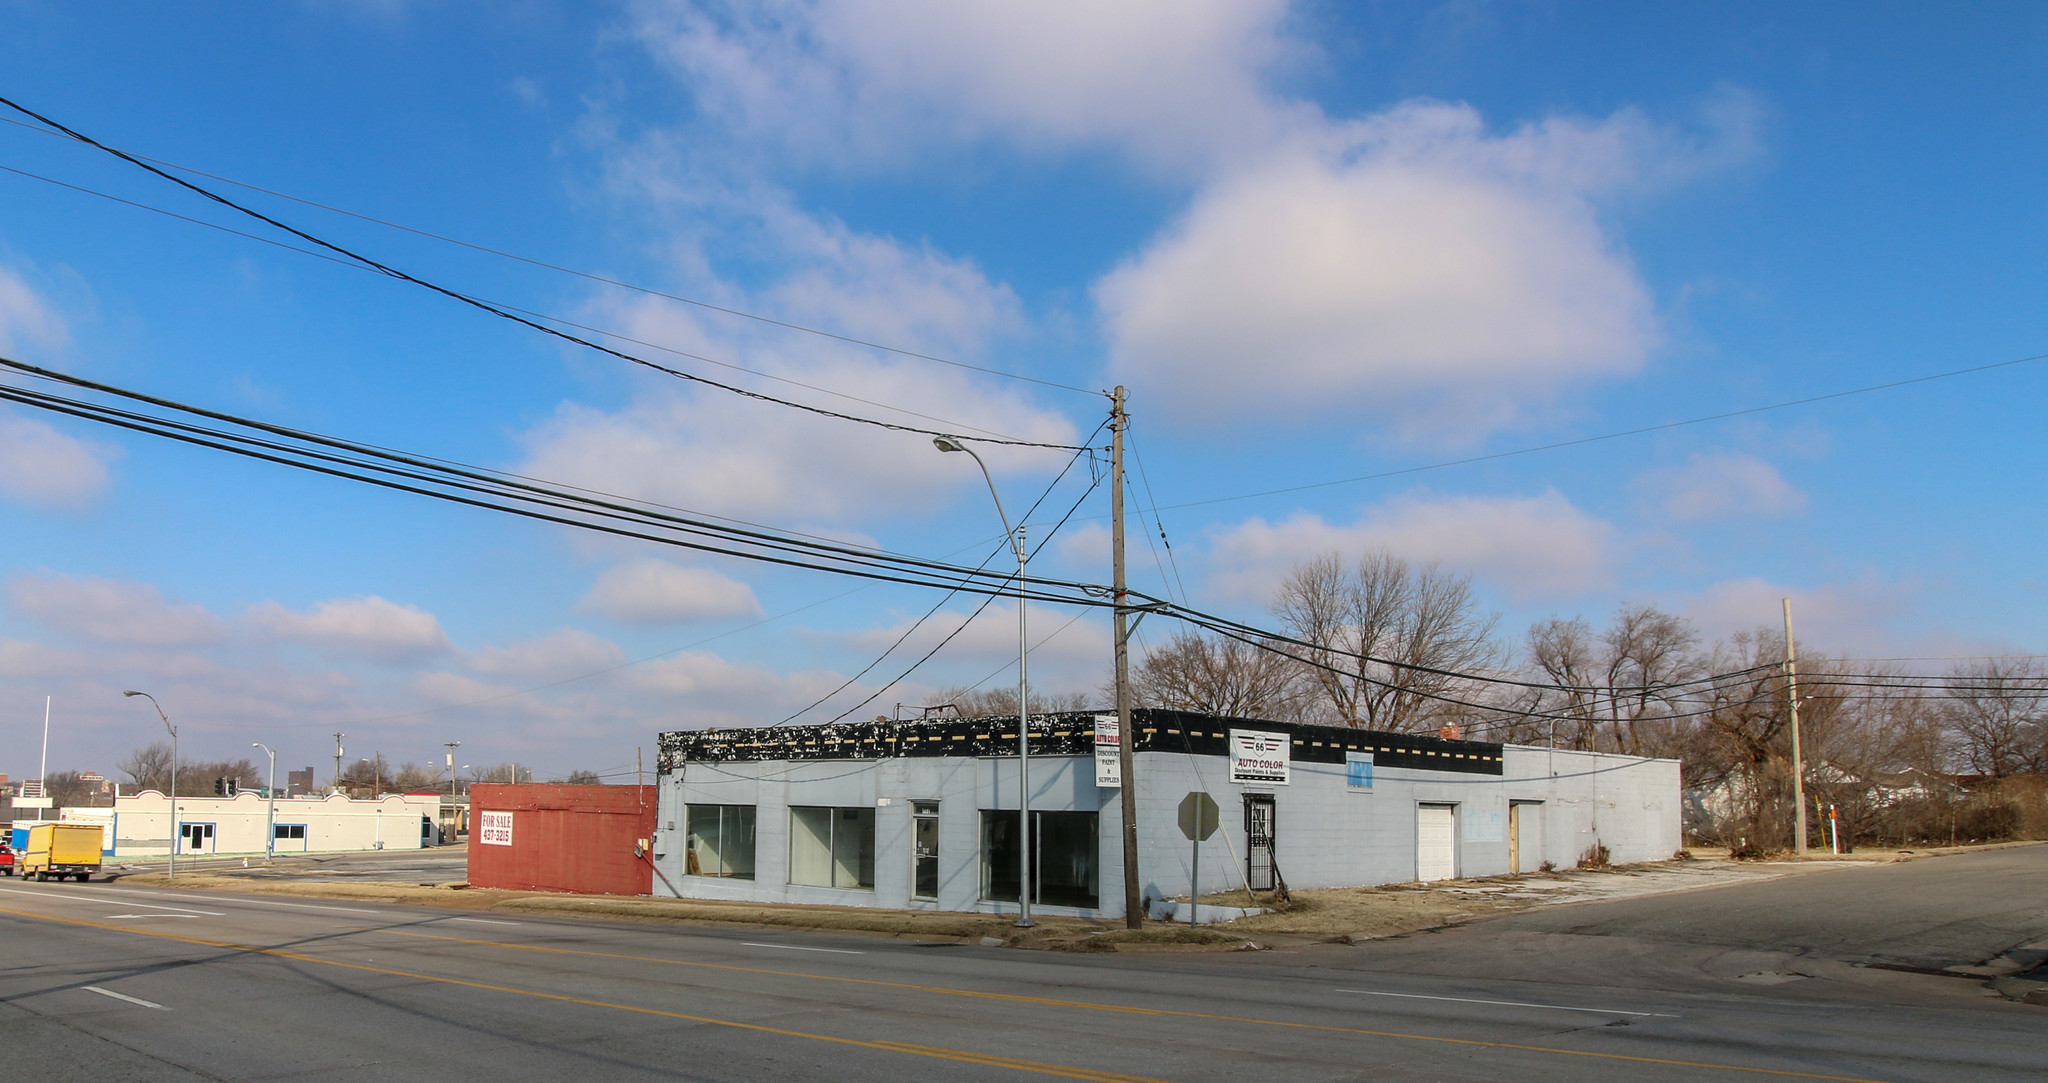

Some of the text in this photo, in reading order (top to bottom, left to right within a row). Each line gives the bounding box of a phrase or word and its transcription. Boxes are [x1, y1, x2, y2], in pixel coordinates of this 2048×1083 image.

[1096, 734, 1107, 742] AUTO
[1255, 742, 1265, 751] 66
[1238, 758, 1283, 769] AUTO COLOR
[483, 815, 511, 828] FOR SALE
[484, 829, 509, 841] 437-3215
